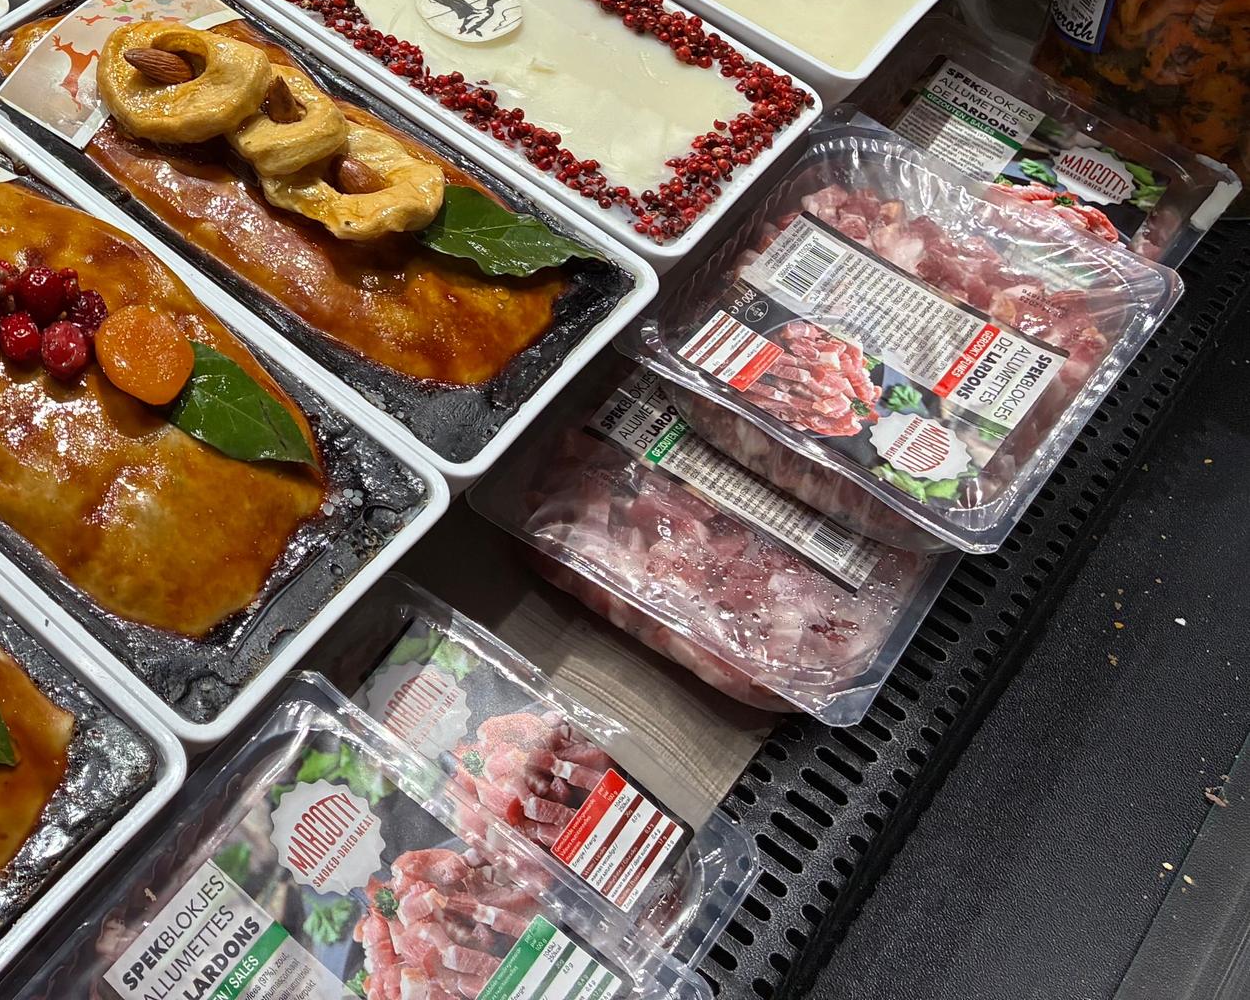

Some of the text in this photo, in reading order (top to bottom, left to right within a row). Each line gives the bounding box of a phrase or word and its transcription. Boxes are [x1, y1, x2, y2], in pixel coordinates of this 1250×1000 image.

[932, 85, 1018, 139] DE LARDONS
[939, 77, 1019, 126] ALLUMETTES
[946, 68, 1035, 122] SPEKBLOKJES
[1061, 153, 1129, 195] MARCOTTY
[743, 289, 757, 304] 200
[956, 337, 1013, 400] DE LARDONS
[980, 346, 1032, 406] ALLUMETTES
[993, 354, 1052, 421] SPEKBLOKJES
[600, 370, 660, 430] SPEKBLOKJES
[635, 405, 680, 450] DE LARDO
[651, 432, 676, 457] GEZOUTEN
[897, 424, 950, 473] MARCOTTY
[287, 792, 361, 877] MARCOTTY
[357, 816, 375, 839] MEAT
[121, 874, 226, 991] SPEKBLOKJES
[183, 915, 261, 1000] LARDONS
[230, 955, 260, 989] SALÉS
